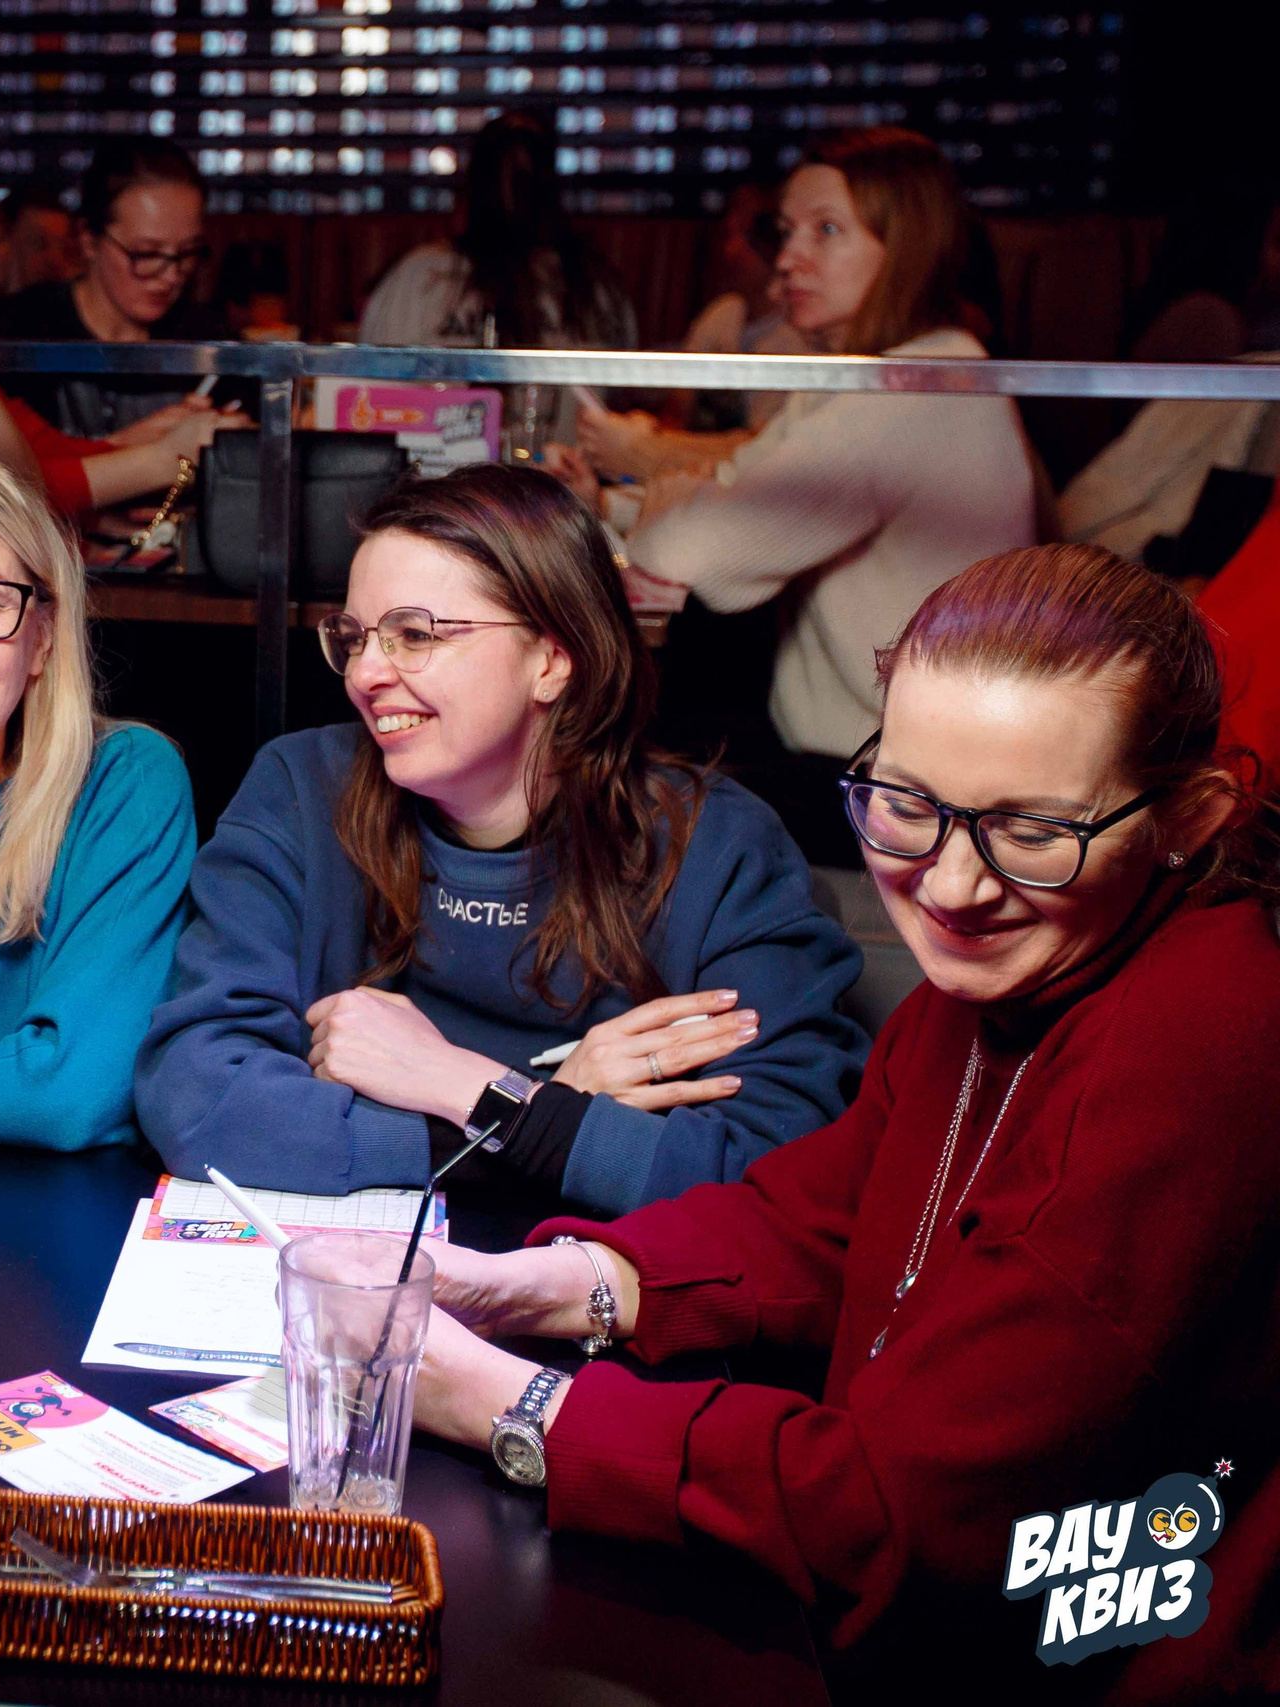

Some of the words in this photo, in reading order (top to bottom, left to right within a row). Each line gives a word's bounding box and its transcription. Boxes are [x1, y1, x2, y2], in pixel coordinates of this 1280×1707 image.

[184, 1222, 234, 1232] КВИЗ
[200, 1229, 244, 1239] ВАУ
[200, 1353, 284, 1365] РАВИЛЬНЫХ
